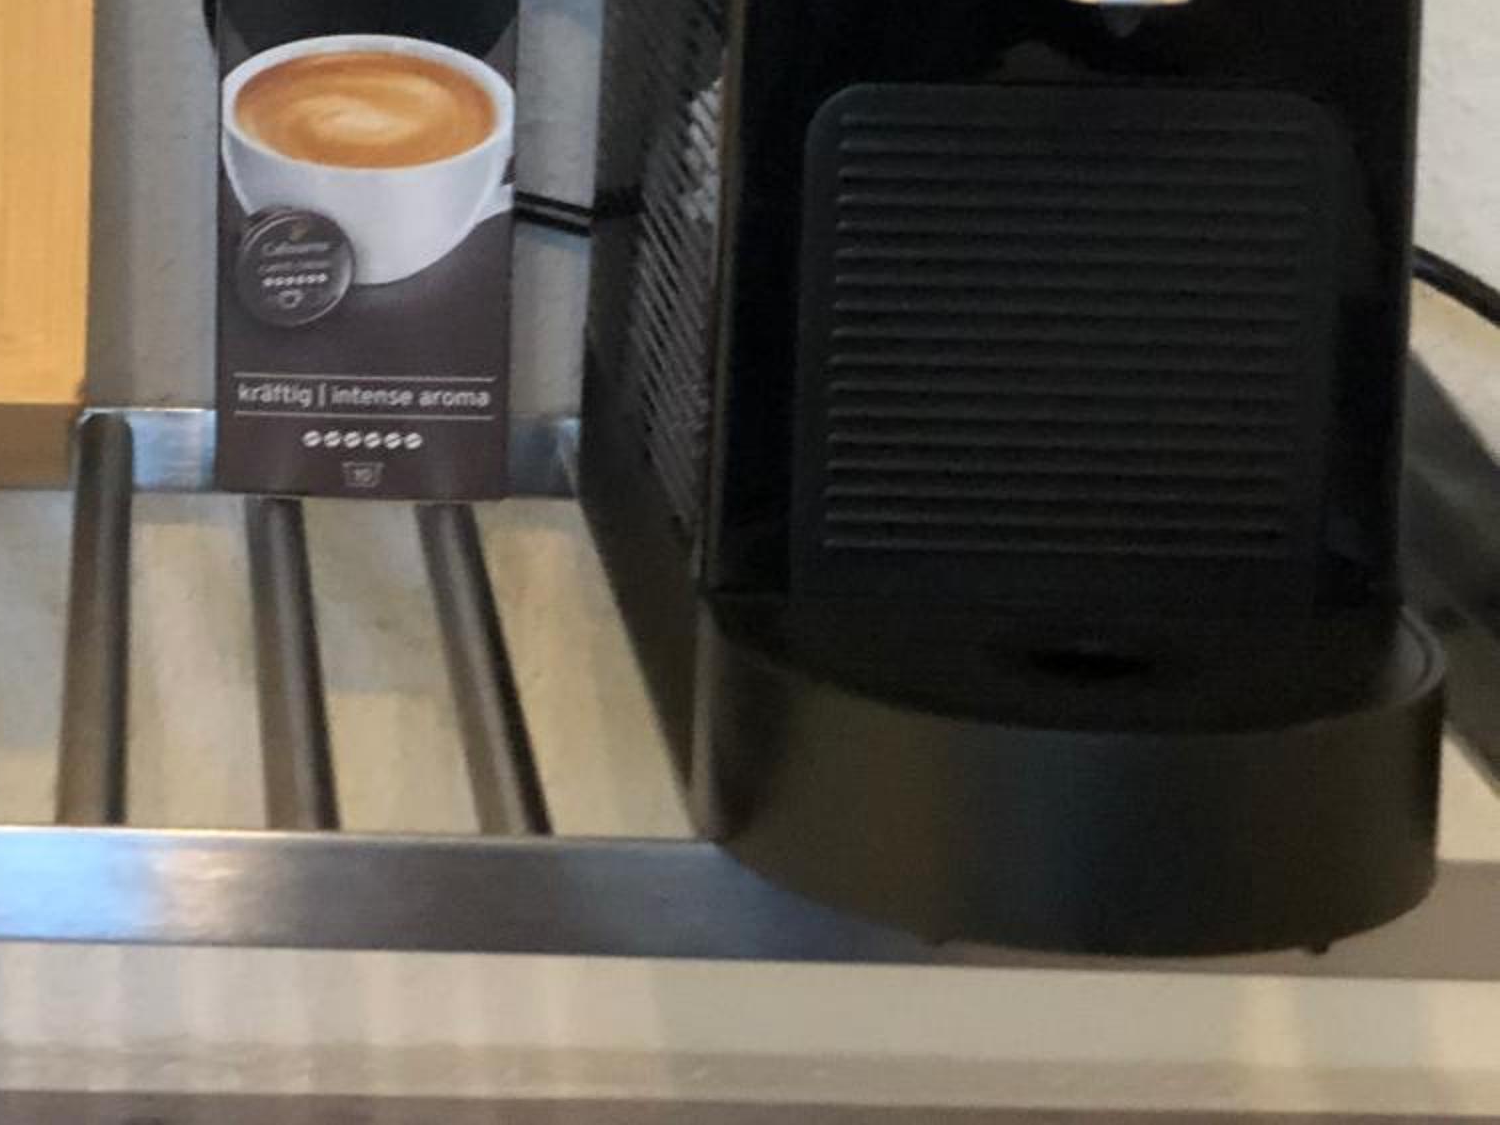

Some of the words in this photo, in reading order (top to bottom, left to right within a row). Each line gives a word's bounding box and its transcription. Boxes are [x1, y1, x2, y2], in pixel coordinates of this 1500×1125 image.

[238, 382, 313, 408] kräftig
[331, 385, 413, 407] intense
[419, 389, 491, 408] aroma
